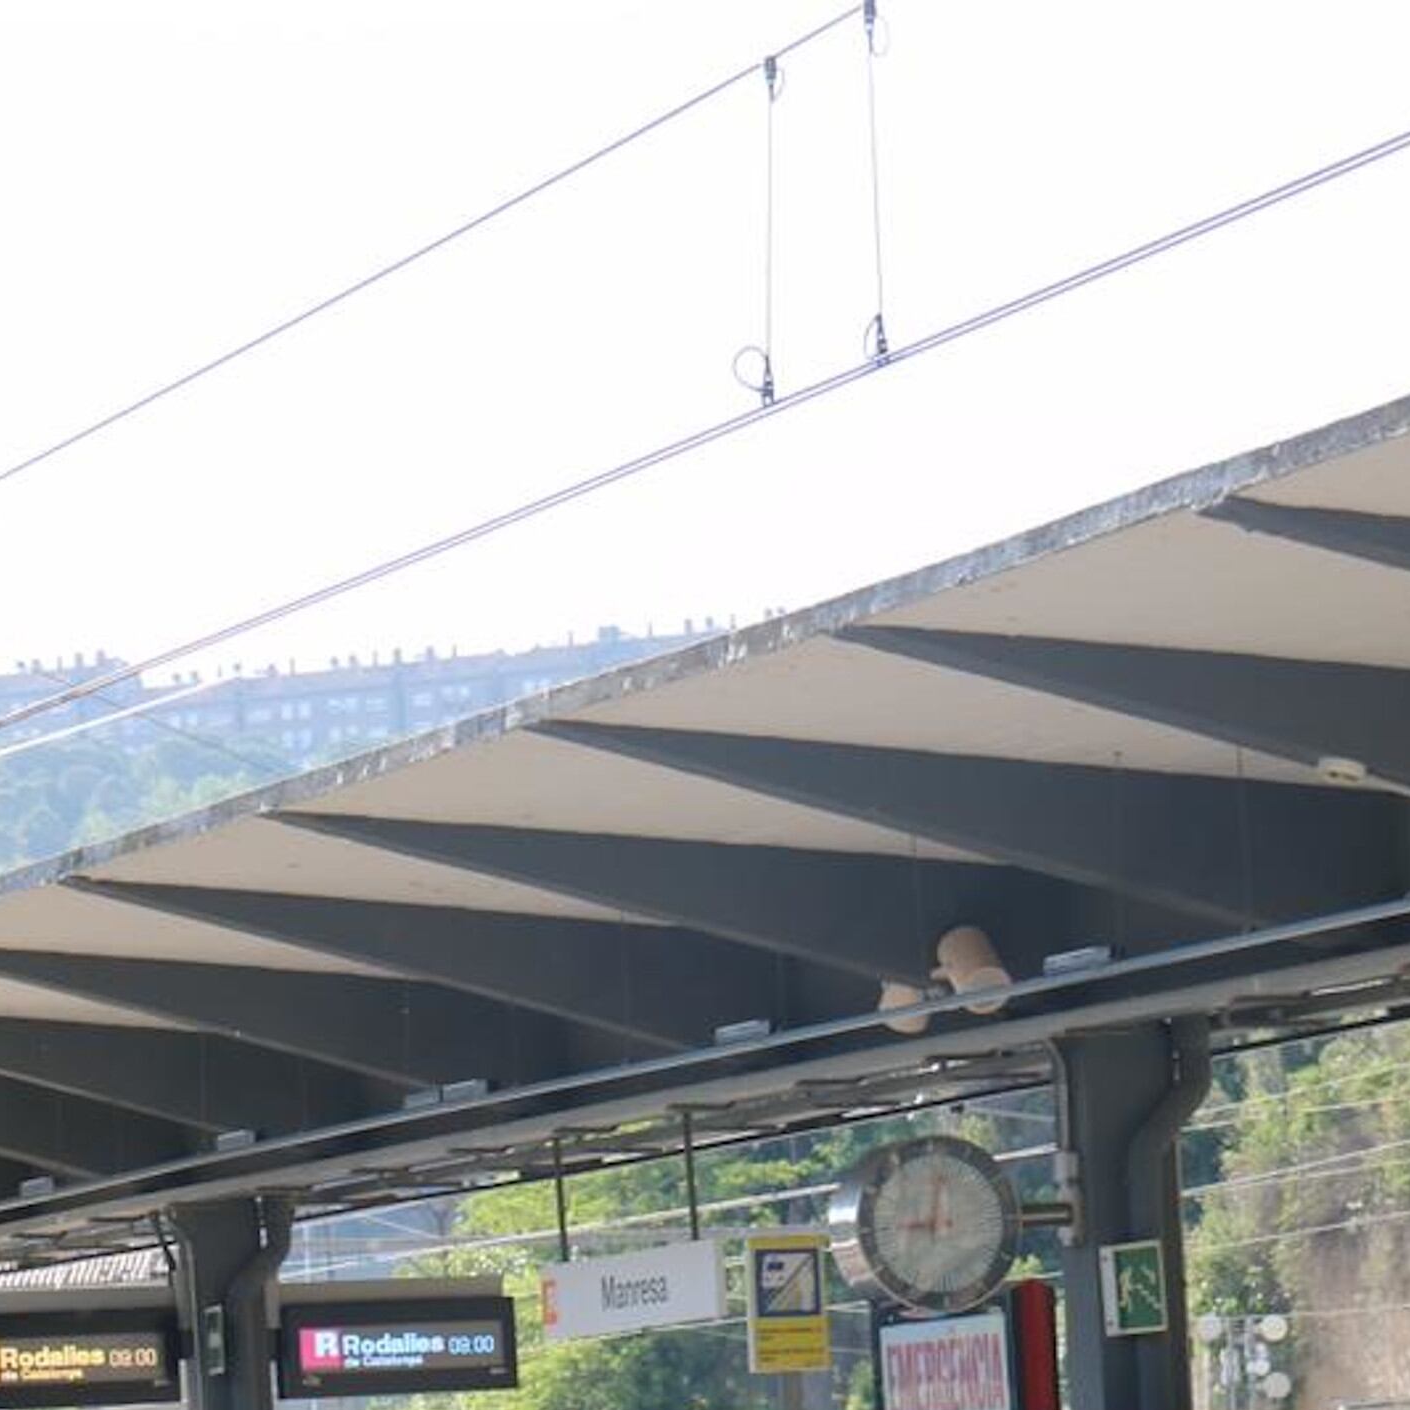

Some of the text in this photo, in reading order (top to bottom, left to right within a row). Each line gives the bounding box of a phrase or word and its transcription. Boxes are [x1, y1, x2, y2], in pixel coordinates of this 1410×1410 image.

[601, 1274, 668, 1311] Manresa
[342, 1332, 445, 1356] Rodalies
[0, 1346, 106, 1369] Rodalies
